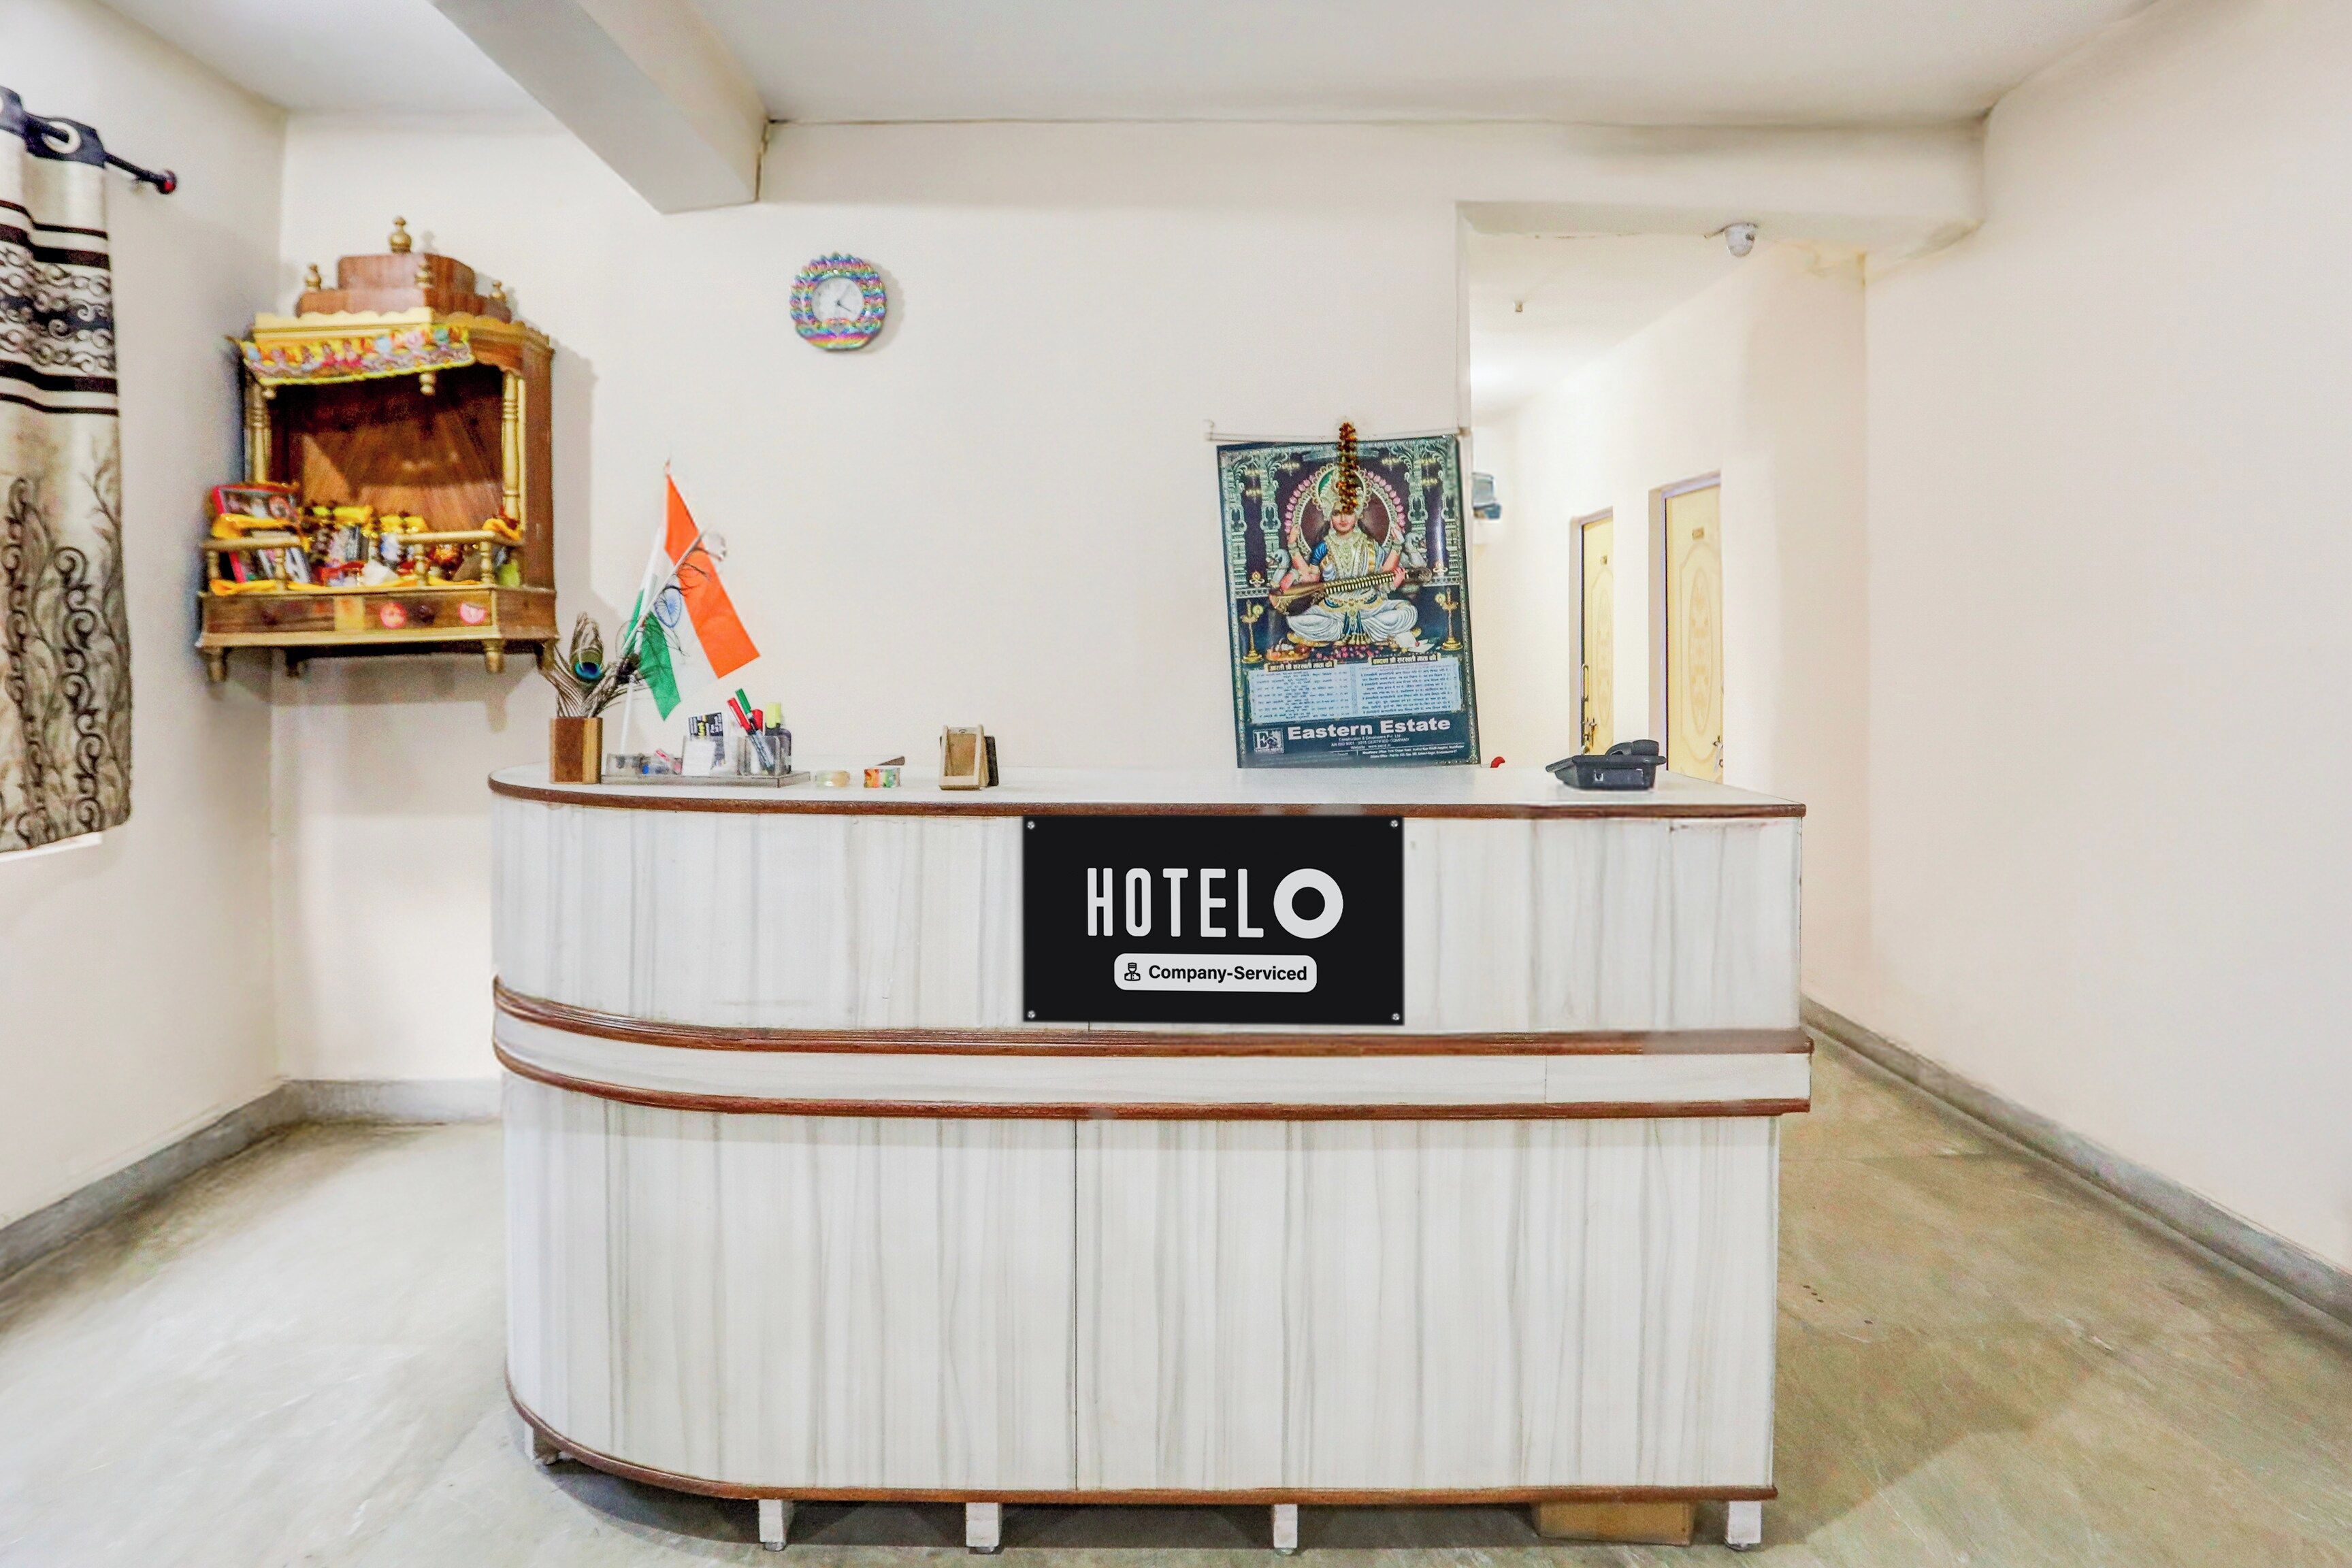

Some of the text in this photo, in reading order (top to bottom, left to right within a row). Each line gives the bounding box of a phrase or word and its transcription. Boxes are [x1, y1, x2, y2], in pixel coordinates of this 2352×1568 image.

[1288, 717, 1451, 740] Eastern Estate
[1088, 868, 1343, 938] HOTEL O
[1148, 965, 1307, 983] Company-Serviced
